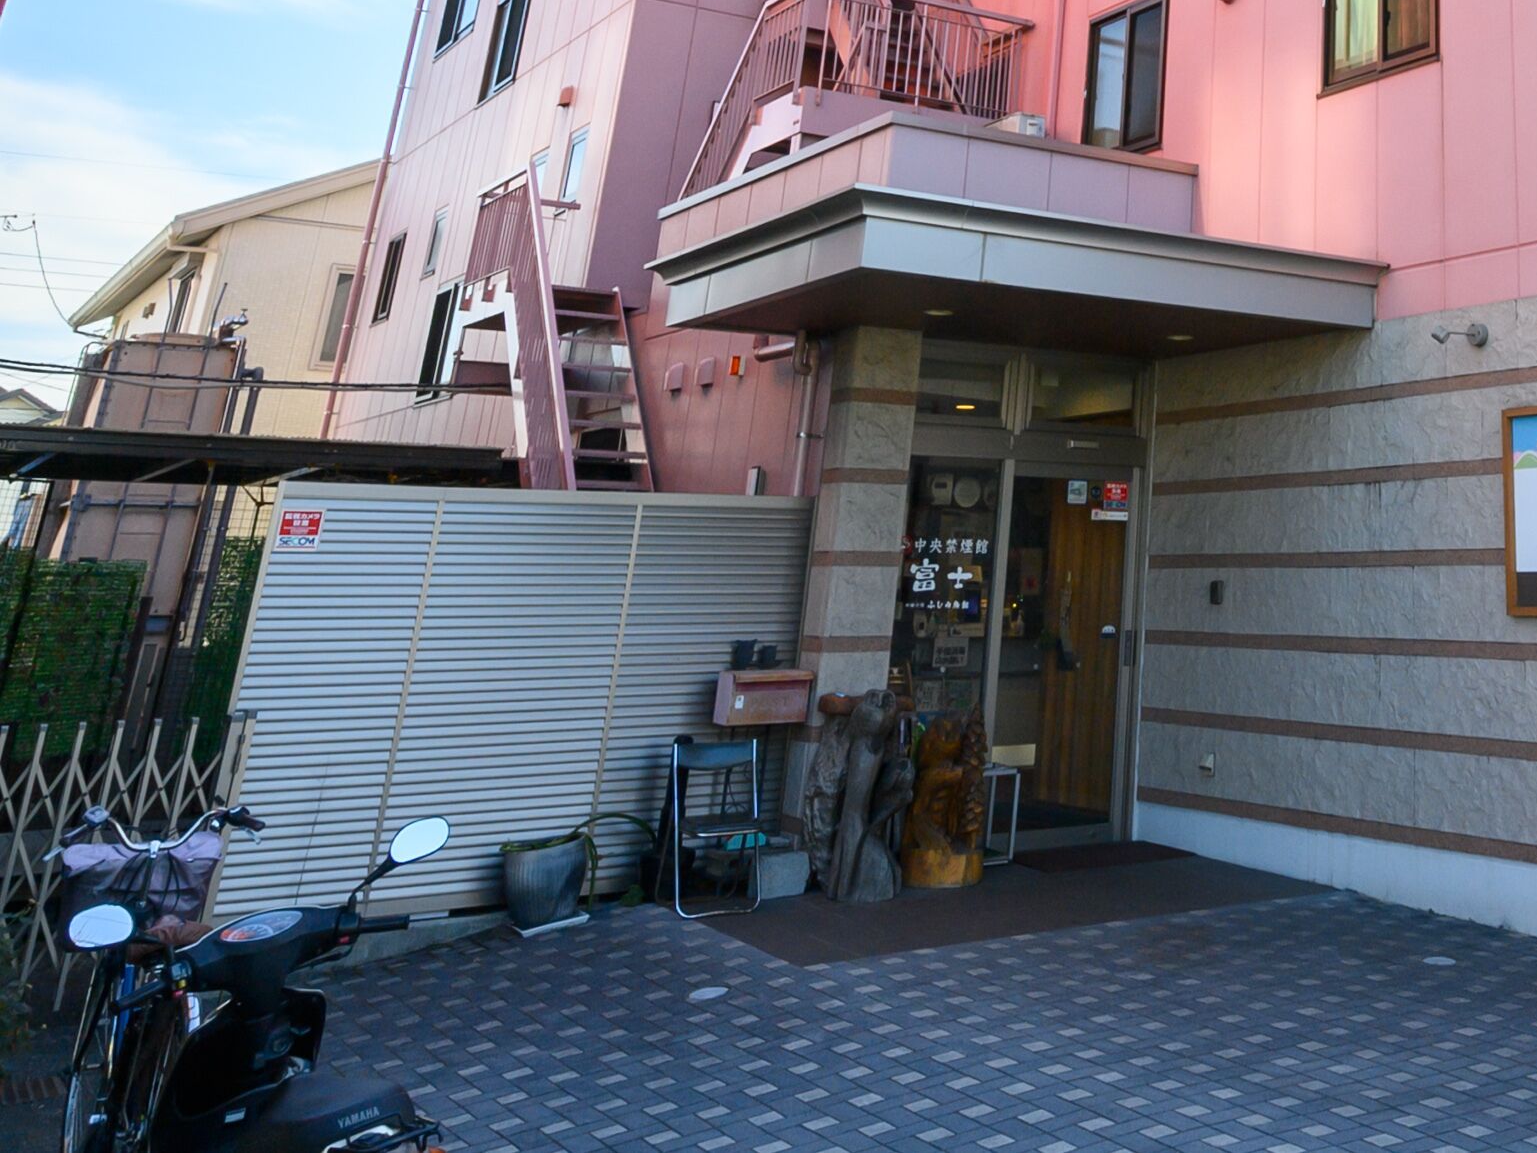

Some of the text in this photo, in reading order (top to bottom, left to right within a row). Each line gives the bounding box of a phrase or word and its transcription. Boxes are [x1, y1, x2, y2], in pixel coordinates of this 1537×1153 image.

[280, 537, 315, 545] SECOM
[914, 537, 989, 554] 中央禁煙館
[910, 558, 973, 592] 富士
[337, 1106, 380, 1128] YAMAHA
